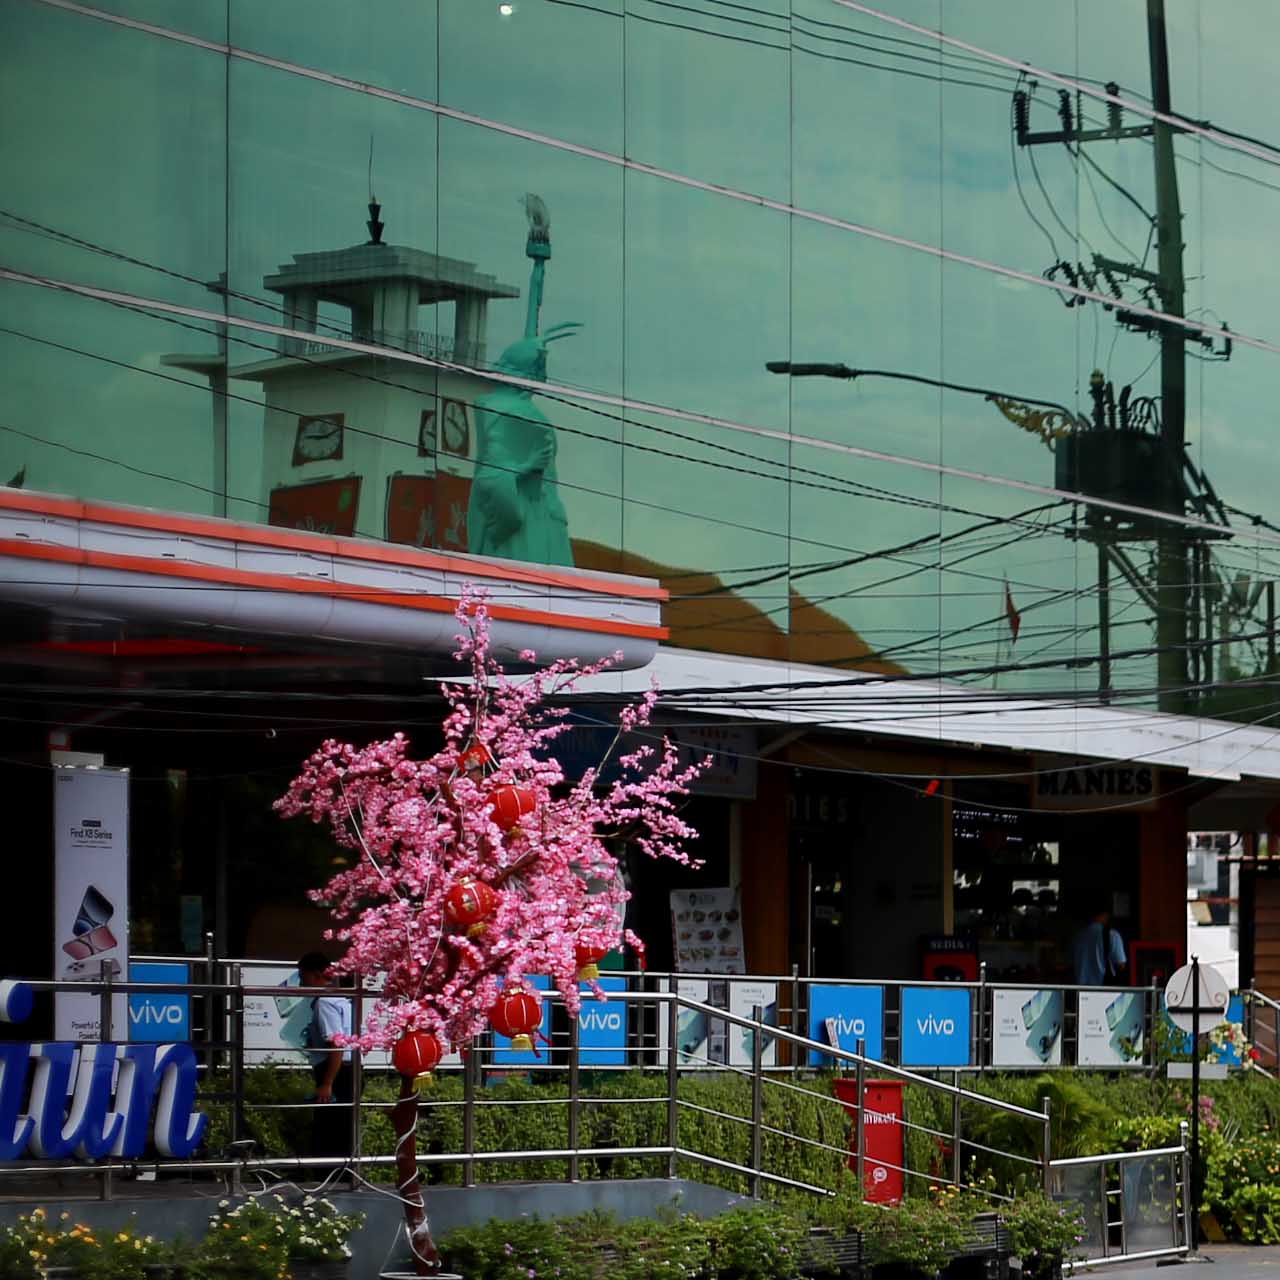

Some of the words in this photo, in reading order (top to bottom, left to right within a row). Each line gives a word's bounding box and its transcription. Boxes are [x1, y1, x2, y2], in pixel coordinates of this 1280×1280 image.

[129, 1000, 183, 1024] vivo
[578, 1008, 621, 1031] vivo
[917, 1013, 955, 1035] vivo
